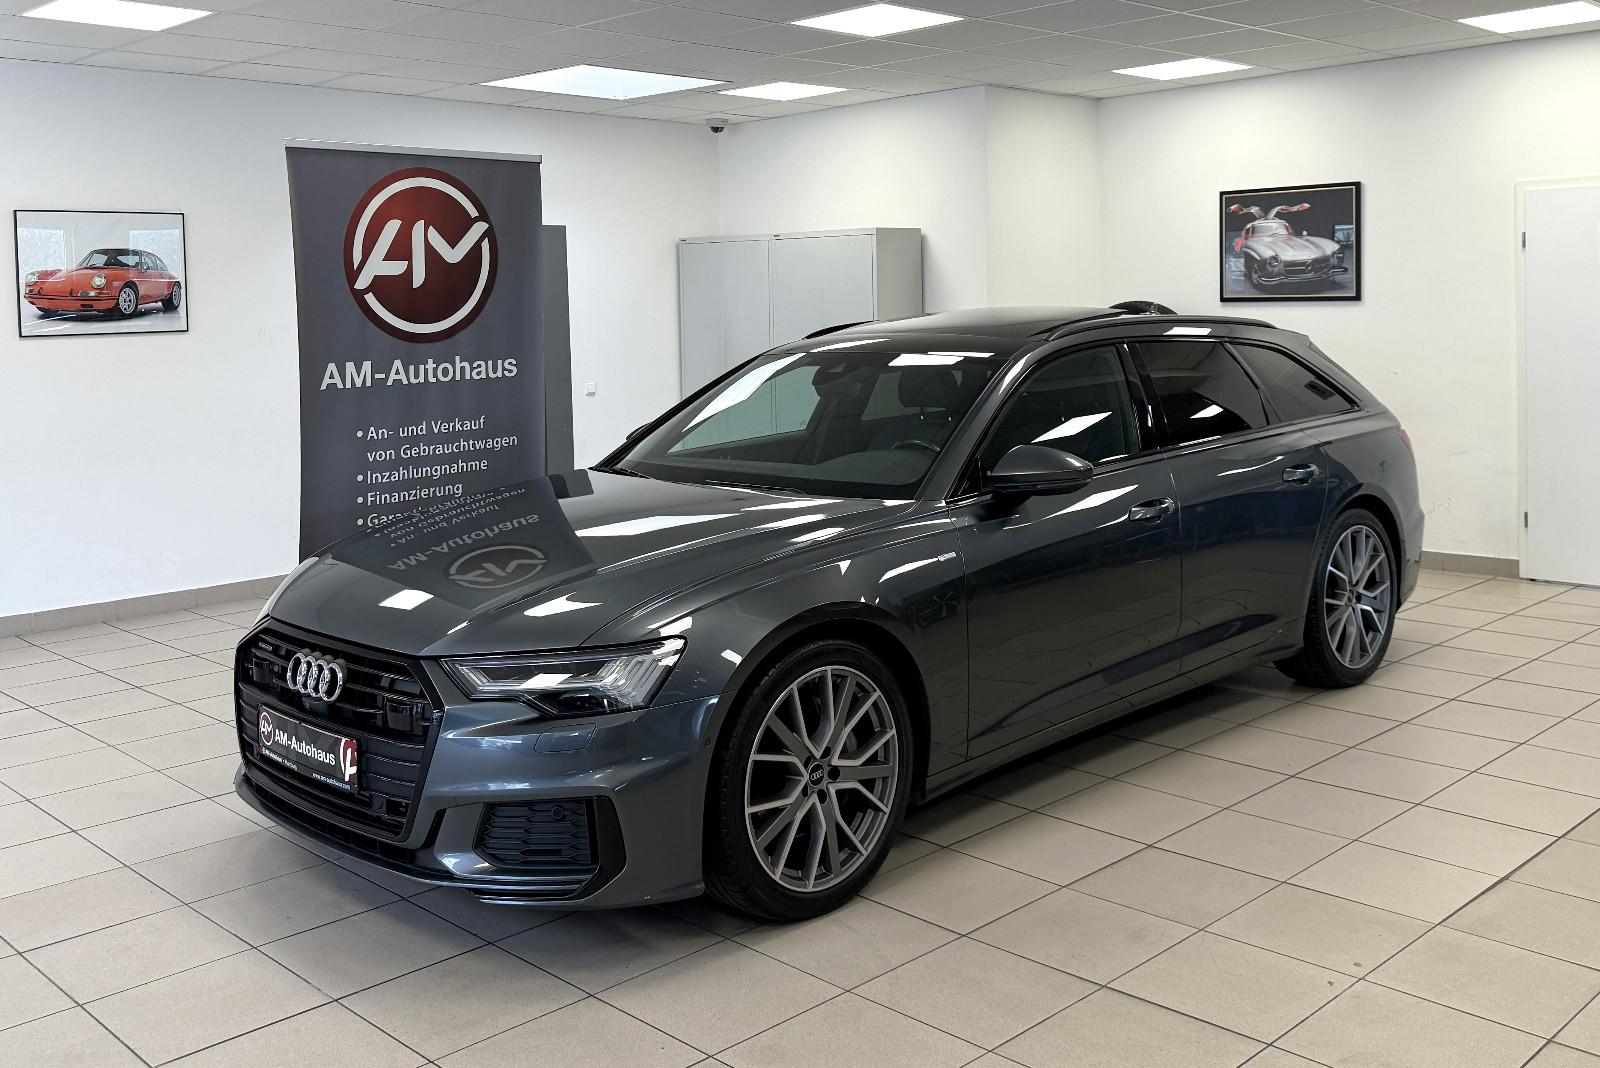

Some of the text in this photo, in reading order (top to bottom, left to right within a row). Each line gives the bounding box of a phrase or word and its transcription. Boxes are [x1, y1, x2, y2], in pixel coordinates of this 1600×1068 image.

[353, 219, 490, 290] AM
[319, 356, 518, 391] AM-Autohaus
[367, 415, 486, 441] An- und Verkauf
[367, 435, 518, 462] von Gebrauchtwagen
[367, 459, 489, 485] Inzahlungnahme
[367, 483, 464, 506] Finanzierung
[274, 728, 336, 766] AM-Autohaus
